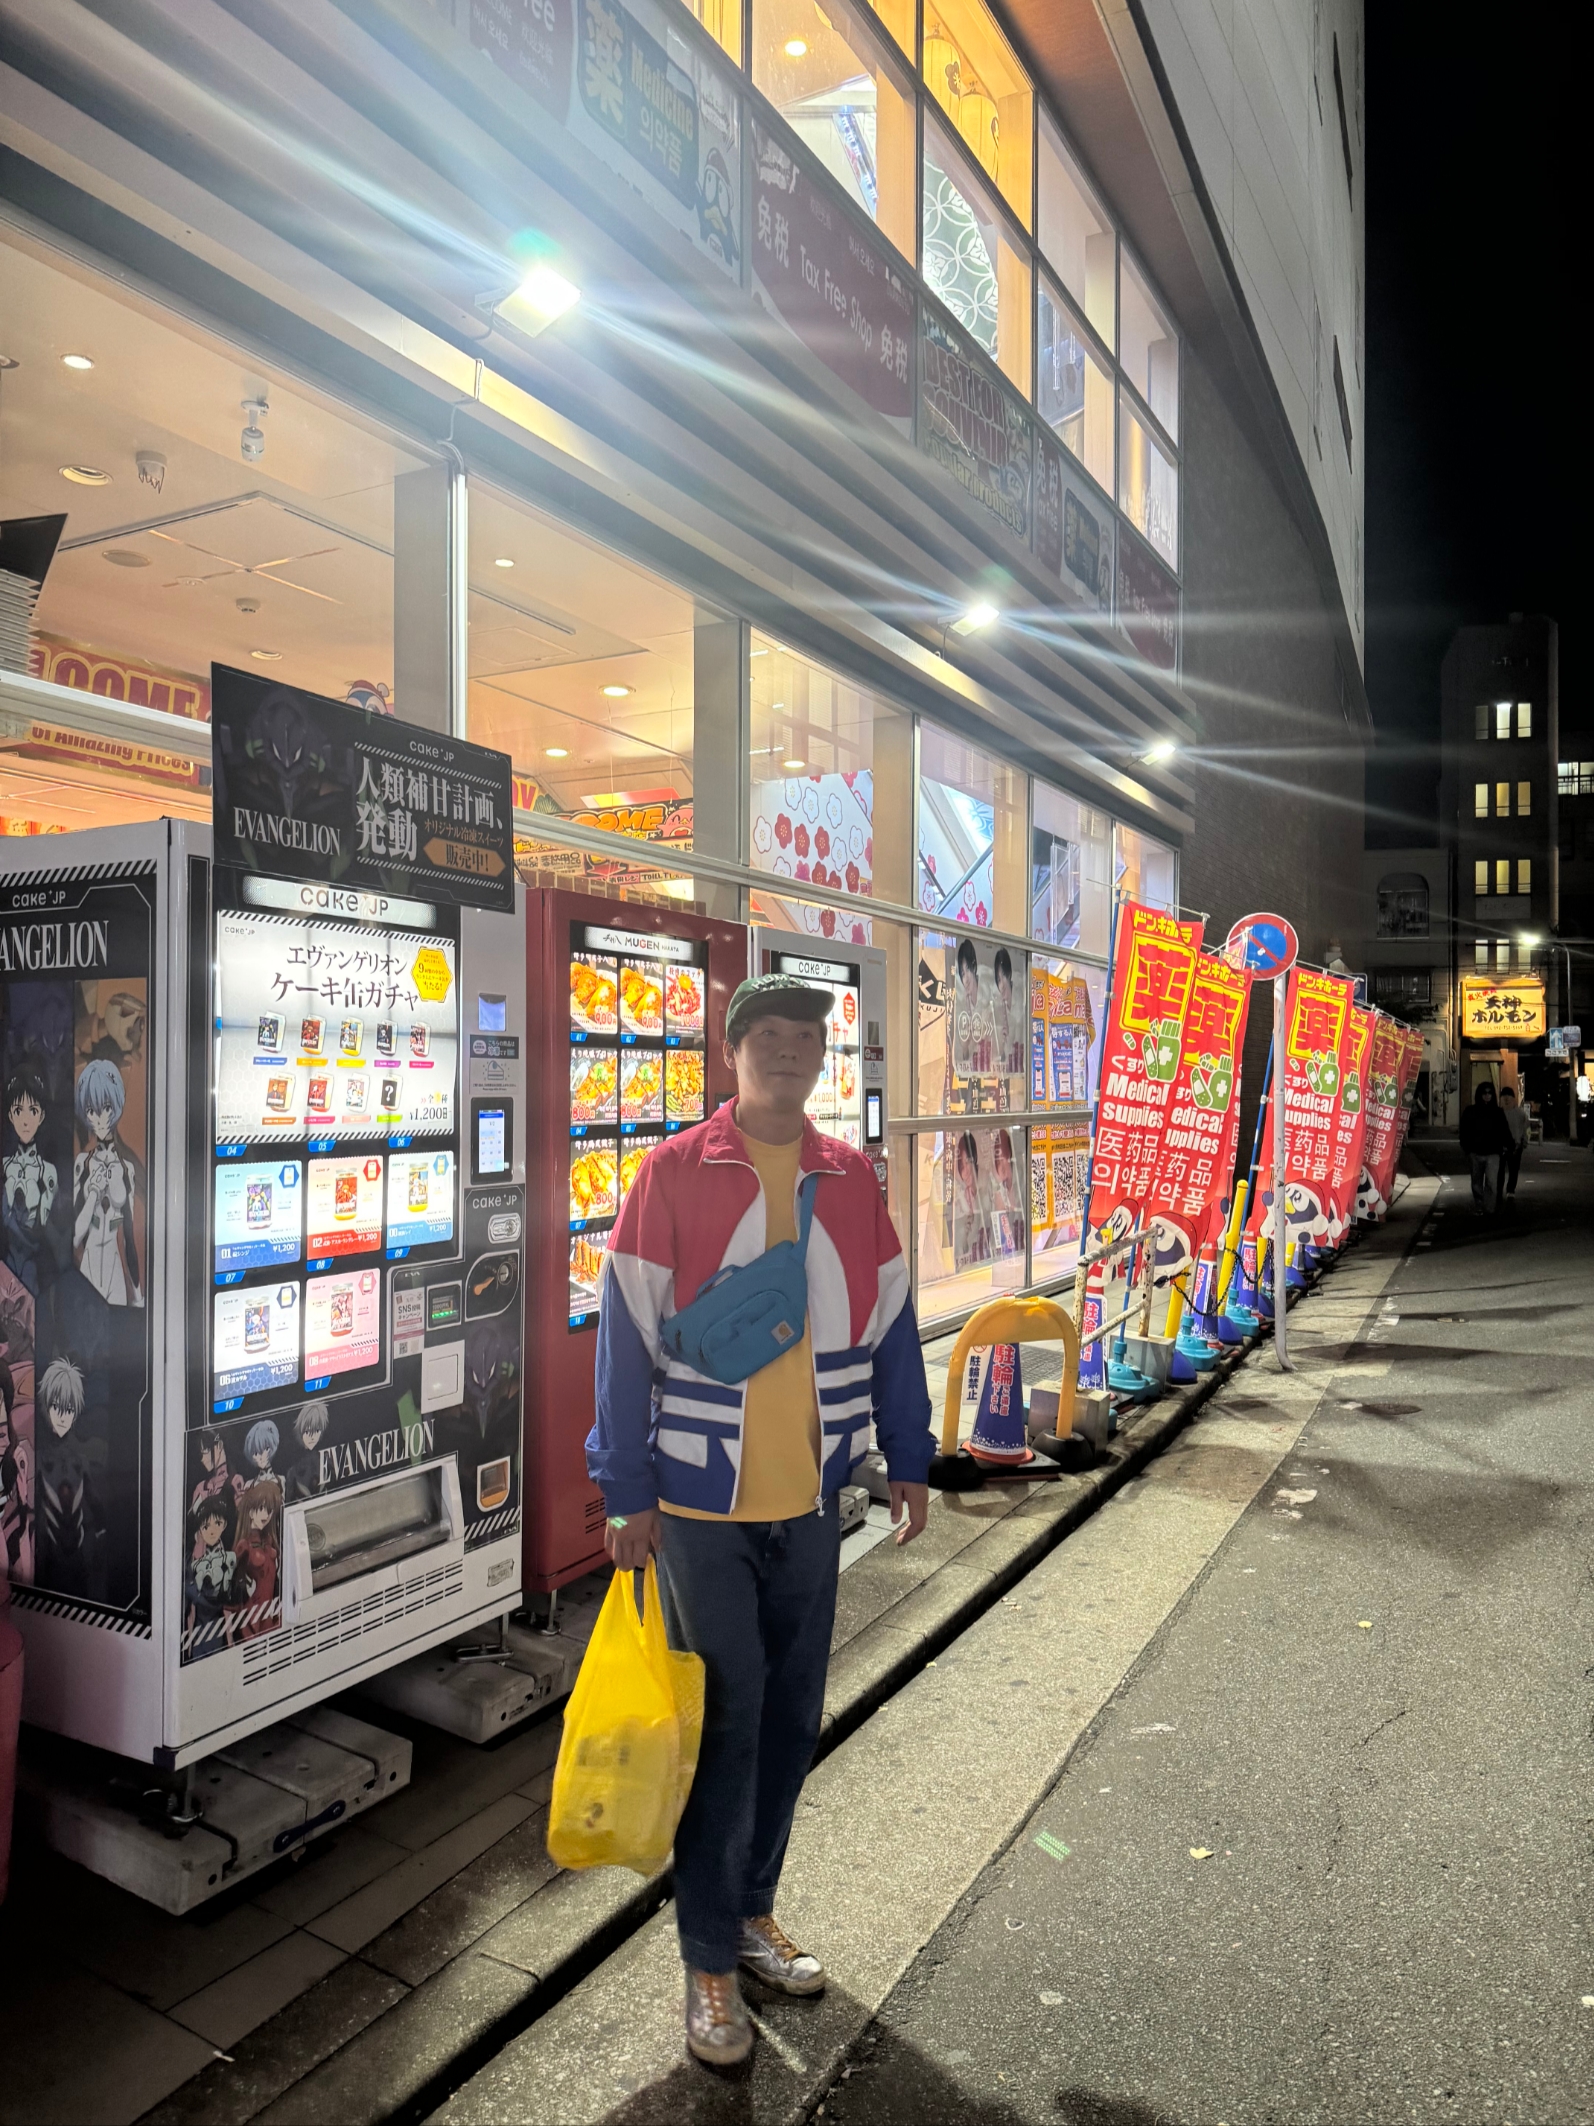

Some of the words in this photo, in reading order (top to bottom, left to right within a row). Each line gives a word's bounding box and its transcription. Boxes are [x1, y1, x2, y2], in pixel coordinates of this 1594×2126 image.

[631, 41, 694, 141] Medicine
[800, 244, 821, 293] Tax
[850, 296, 873, 351] Shop
[233, 806, 341, 856] EVANGELION
[356, 801, 418, 862] 発動
[0, 920, 109, 971] ANGELION
[625, 936, 660, 950] MUGEN
[286, 945, 407, 977] エヴァンゲリオン
[271, 972, 418, 1011] ケーキ缶ガチャ
[1484, 994, 1523, 1010] 天神
[1471, 1008, 1537, 1024] ホルモン
[1111, 1054, 1145, 1074] くすり
[1106, 1072, 1171, 1106] Medical
[1102, 1101, 1165, 1129] supplies
[1170, 1107, 1225, 1135] edical
[1285, 1109, 1331, 1131] upplies
[1096, 1127, 1159, 1164] 医药品
[1165, 1128, 1220, 1155] pplies
[1091, 1163, 1152, 1197] 의약품
[1151, 1178, 1206, 1217] 약품
[966, 1355, 982, 1401] 駐輪禁止
[318, 1419, 436, 1486] EVANGELION
